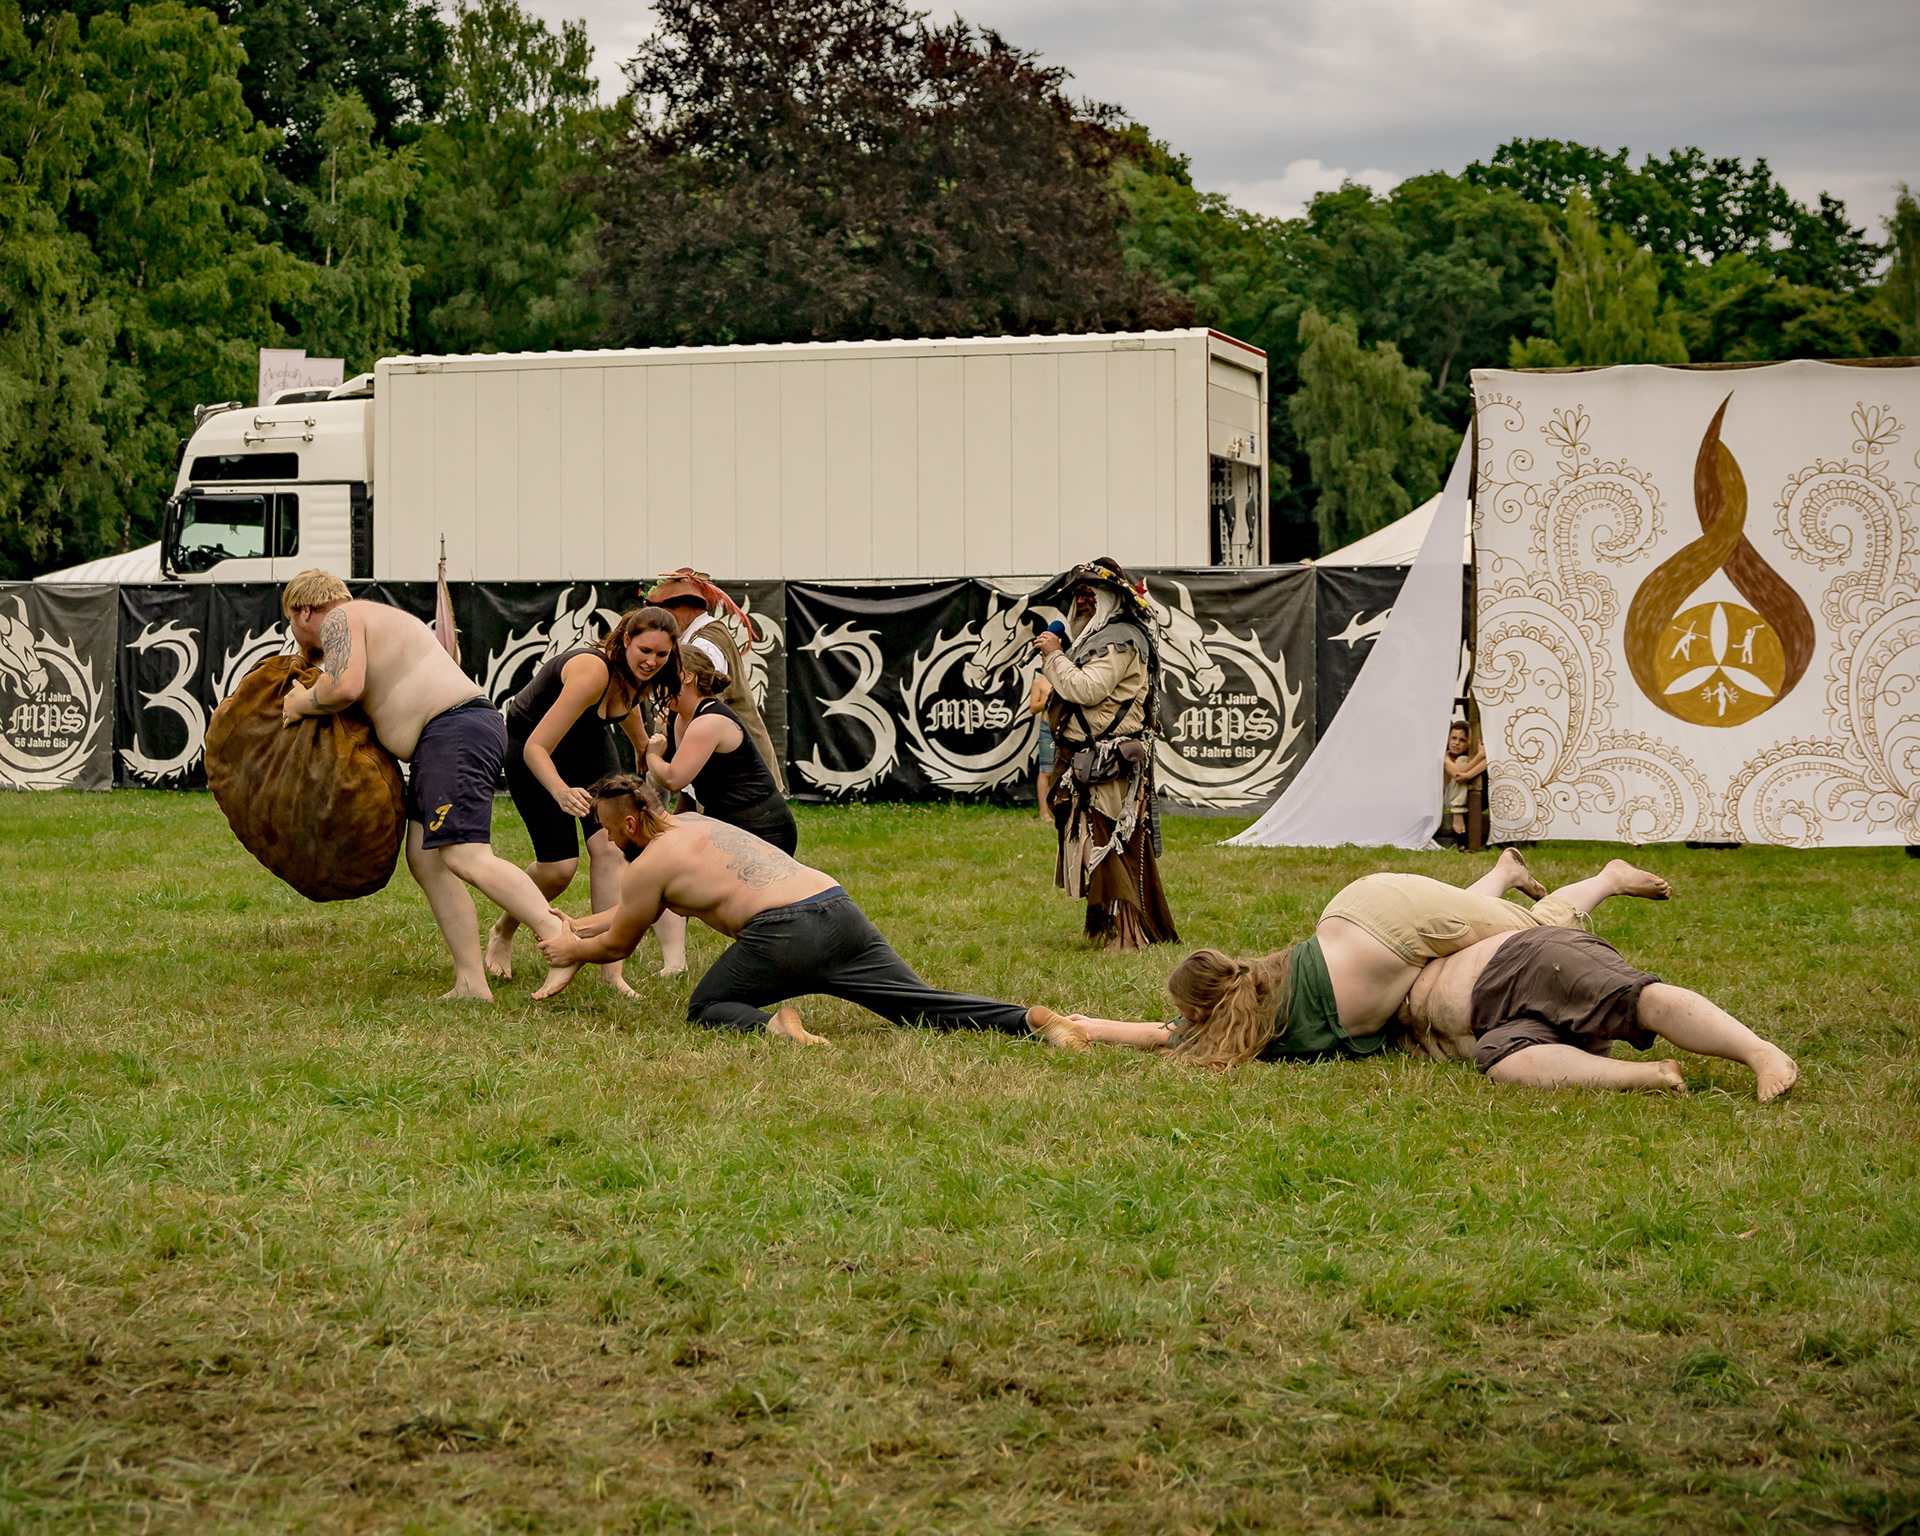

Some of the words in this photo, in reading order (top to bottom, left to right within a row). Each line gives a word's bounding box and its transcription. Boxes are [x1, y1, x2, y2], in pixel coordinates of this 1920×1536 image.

[35, 692, 46, 702] 21
[48, 692, 72, 702] Jahre
[1208, 693, 1222, 705] 21
[1225, 693, 1258, 705] Jahre
[6, 703, 86, 738] MPS
[924, 698, 1013, 734] MPS
[1170, 706, 1279, 746] MPS
[14, 737, 26, 748] 56
[27, 737, 52, 748] Jahre
[53, 737, 69, 748] Gisi
[1183, 746, 1198, 758] 56
[1200, 746, 1232, 758] Jahre
[1234, 746, 1256, 758] Gisi
